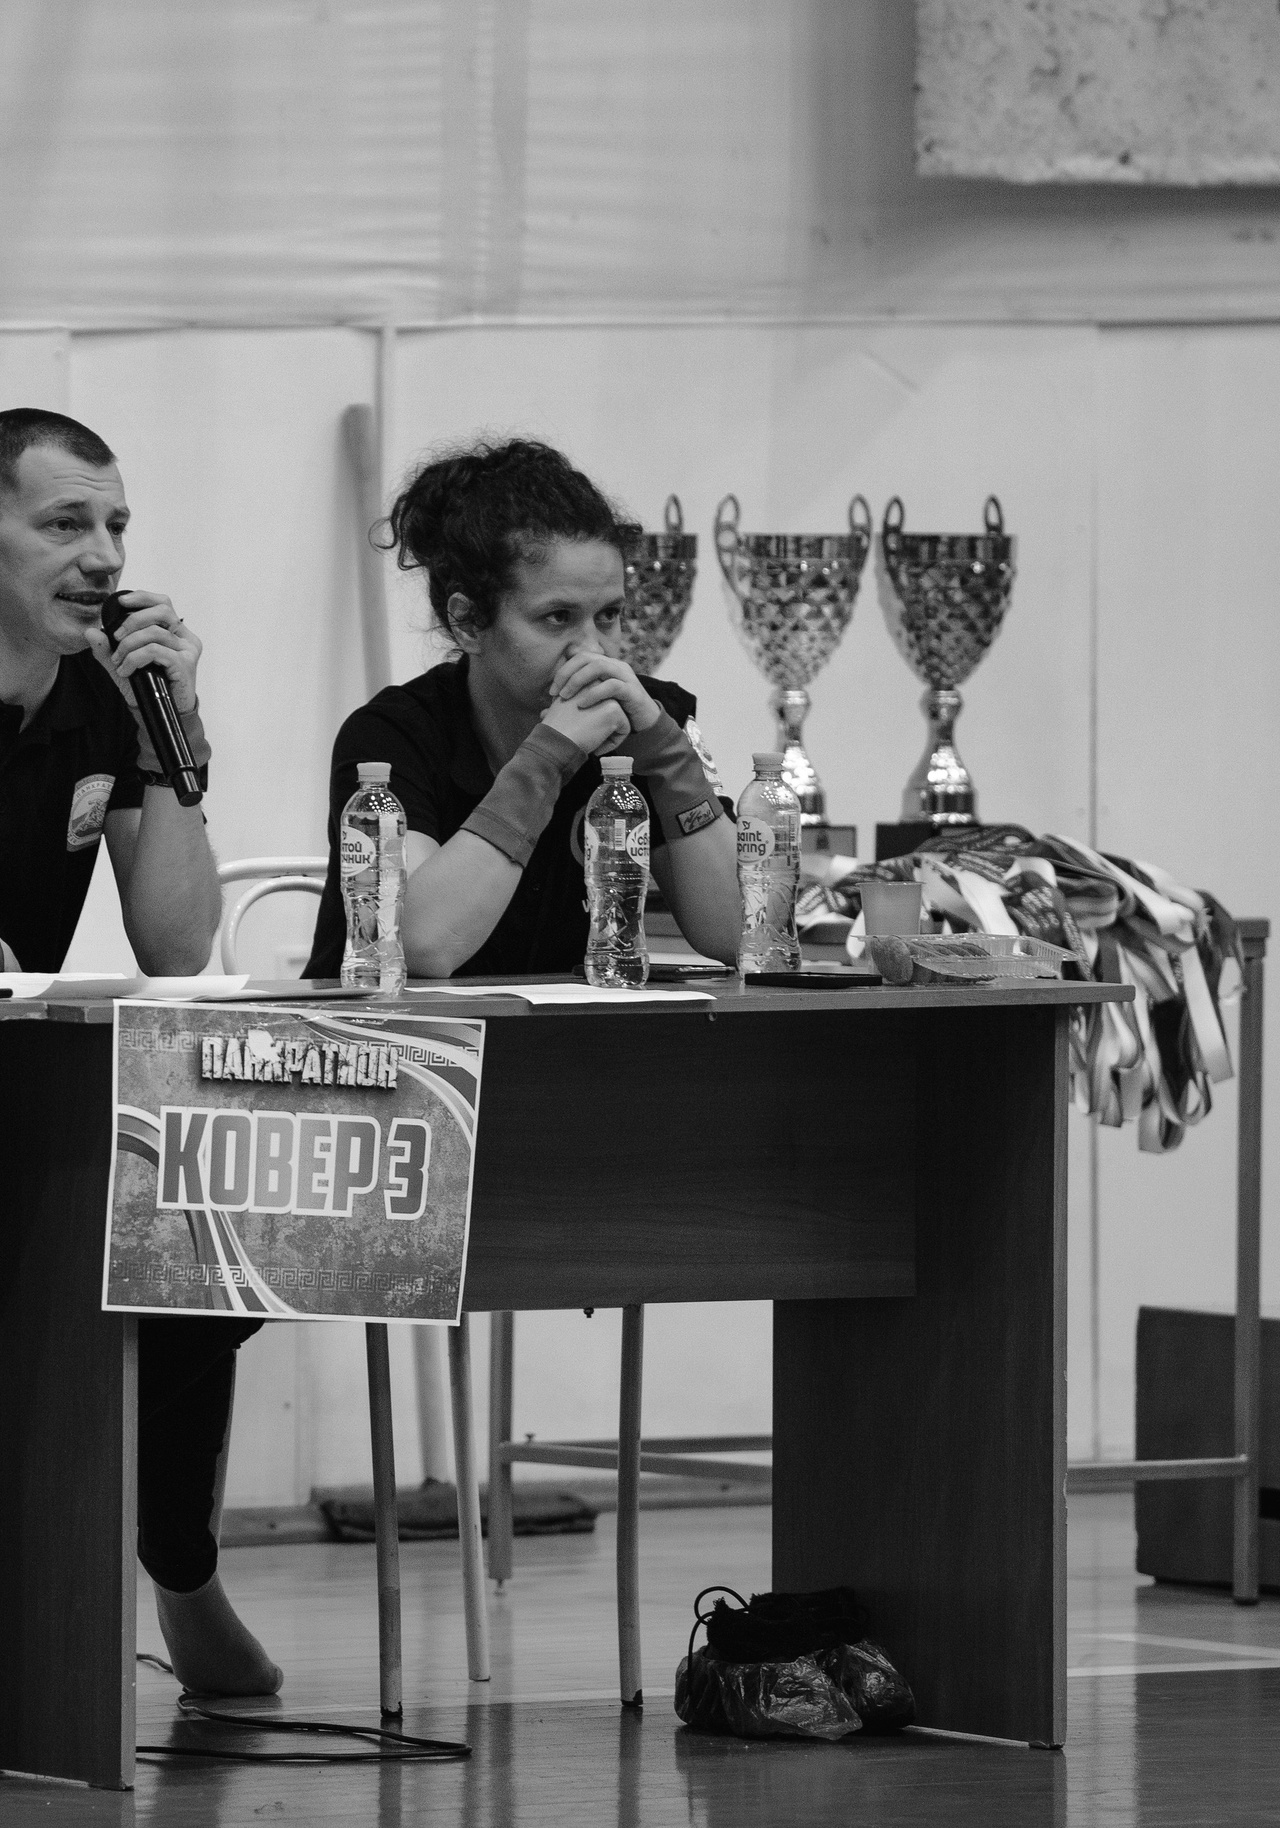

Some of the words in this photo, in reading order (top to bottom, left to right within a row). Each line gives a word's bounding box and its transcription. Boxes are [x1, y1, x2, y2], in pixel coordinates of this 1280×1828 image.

[76, 782, 113, 798] ПАНКРАТ
[342, 841, 363, 853] той
[341, 854, 371, 864] чник
[201, 1032, 398, 1089] ПАНКРАТИОН
[157, 1105, 381, 1218] КОВЕР
[383, 1117, 432, 1221] 3
